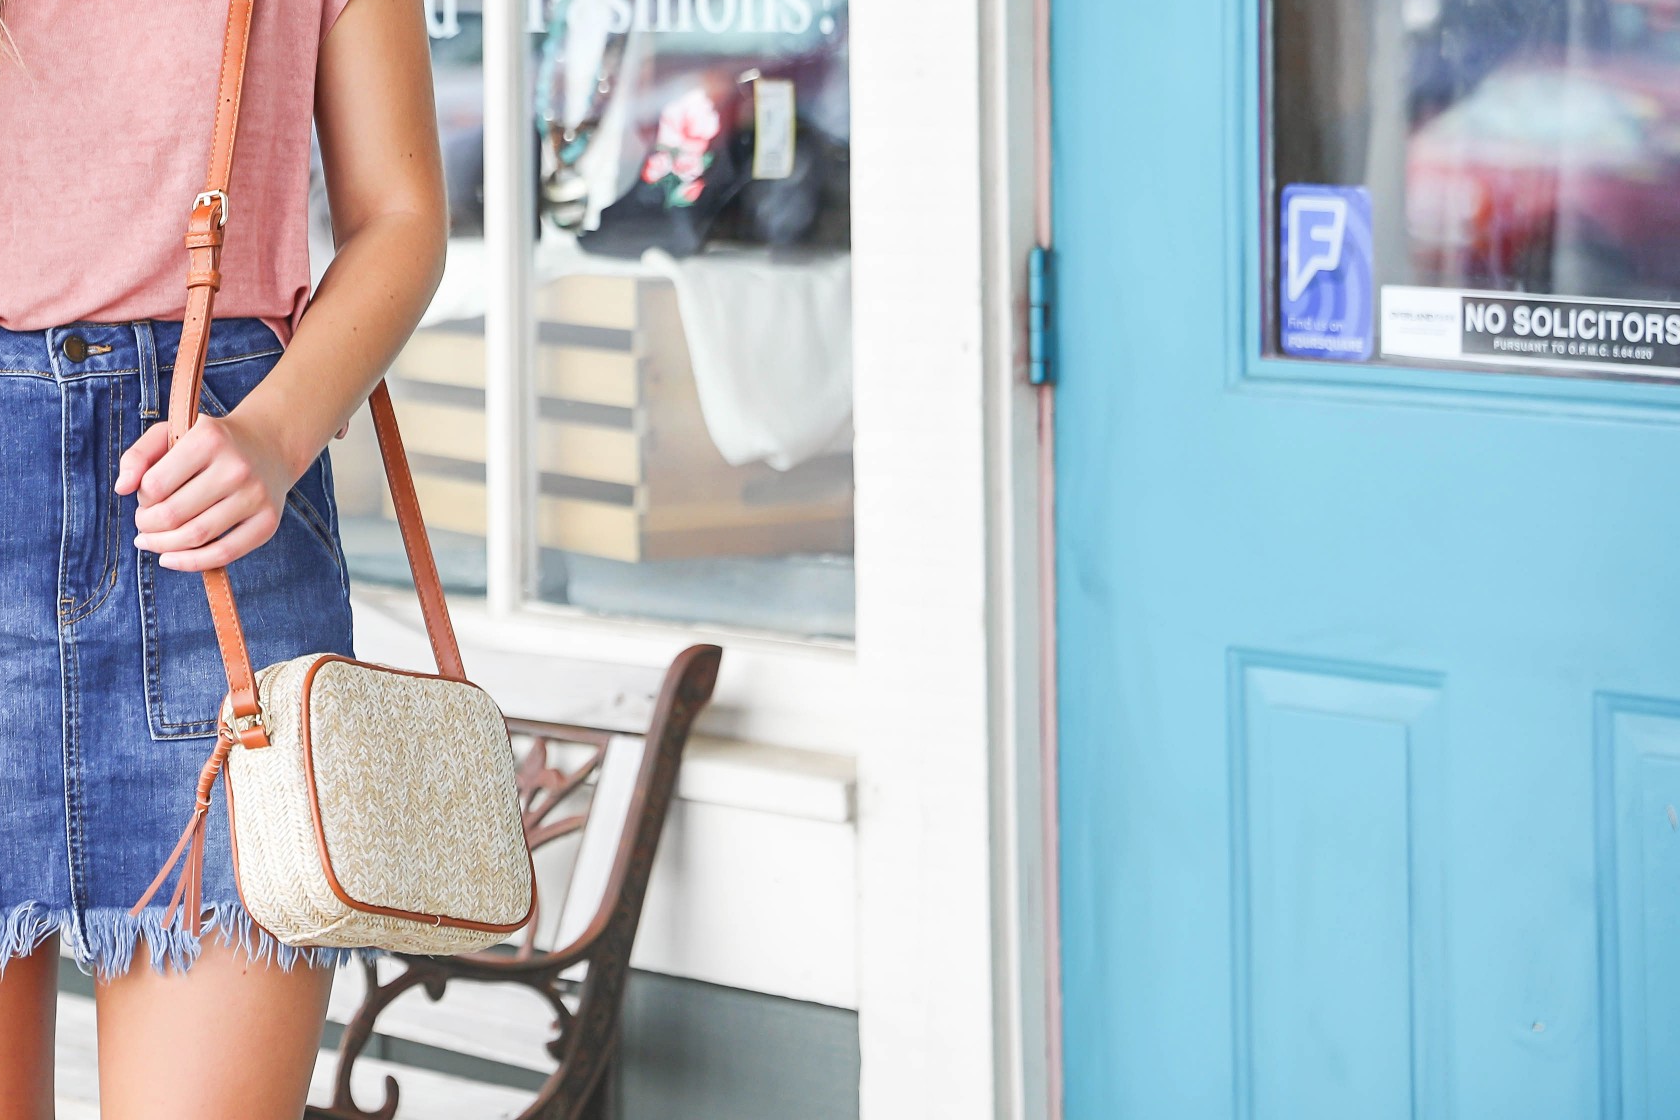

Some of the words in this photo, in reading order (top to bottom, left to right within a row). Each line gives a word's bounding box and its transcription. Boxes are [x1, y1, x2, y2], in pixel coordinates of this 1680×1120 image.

[1464, 302, 1507, 335] NO
[1512, 304, 1680, 346] SOLICITORS
[1493, 337, 1549, 354] PURSUANT
[1551, 342, 1565, 355] TO
